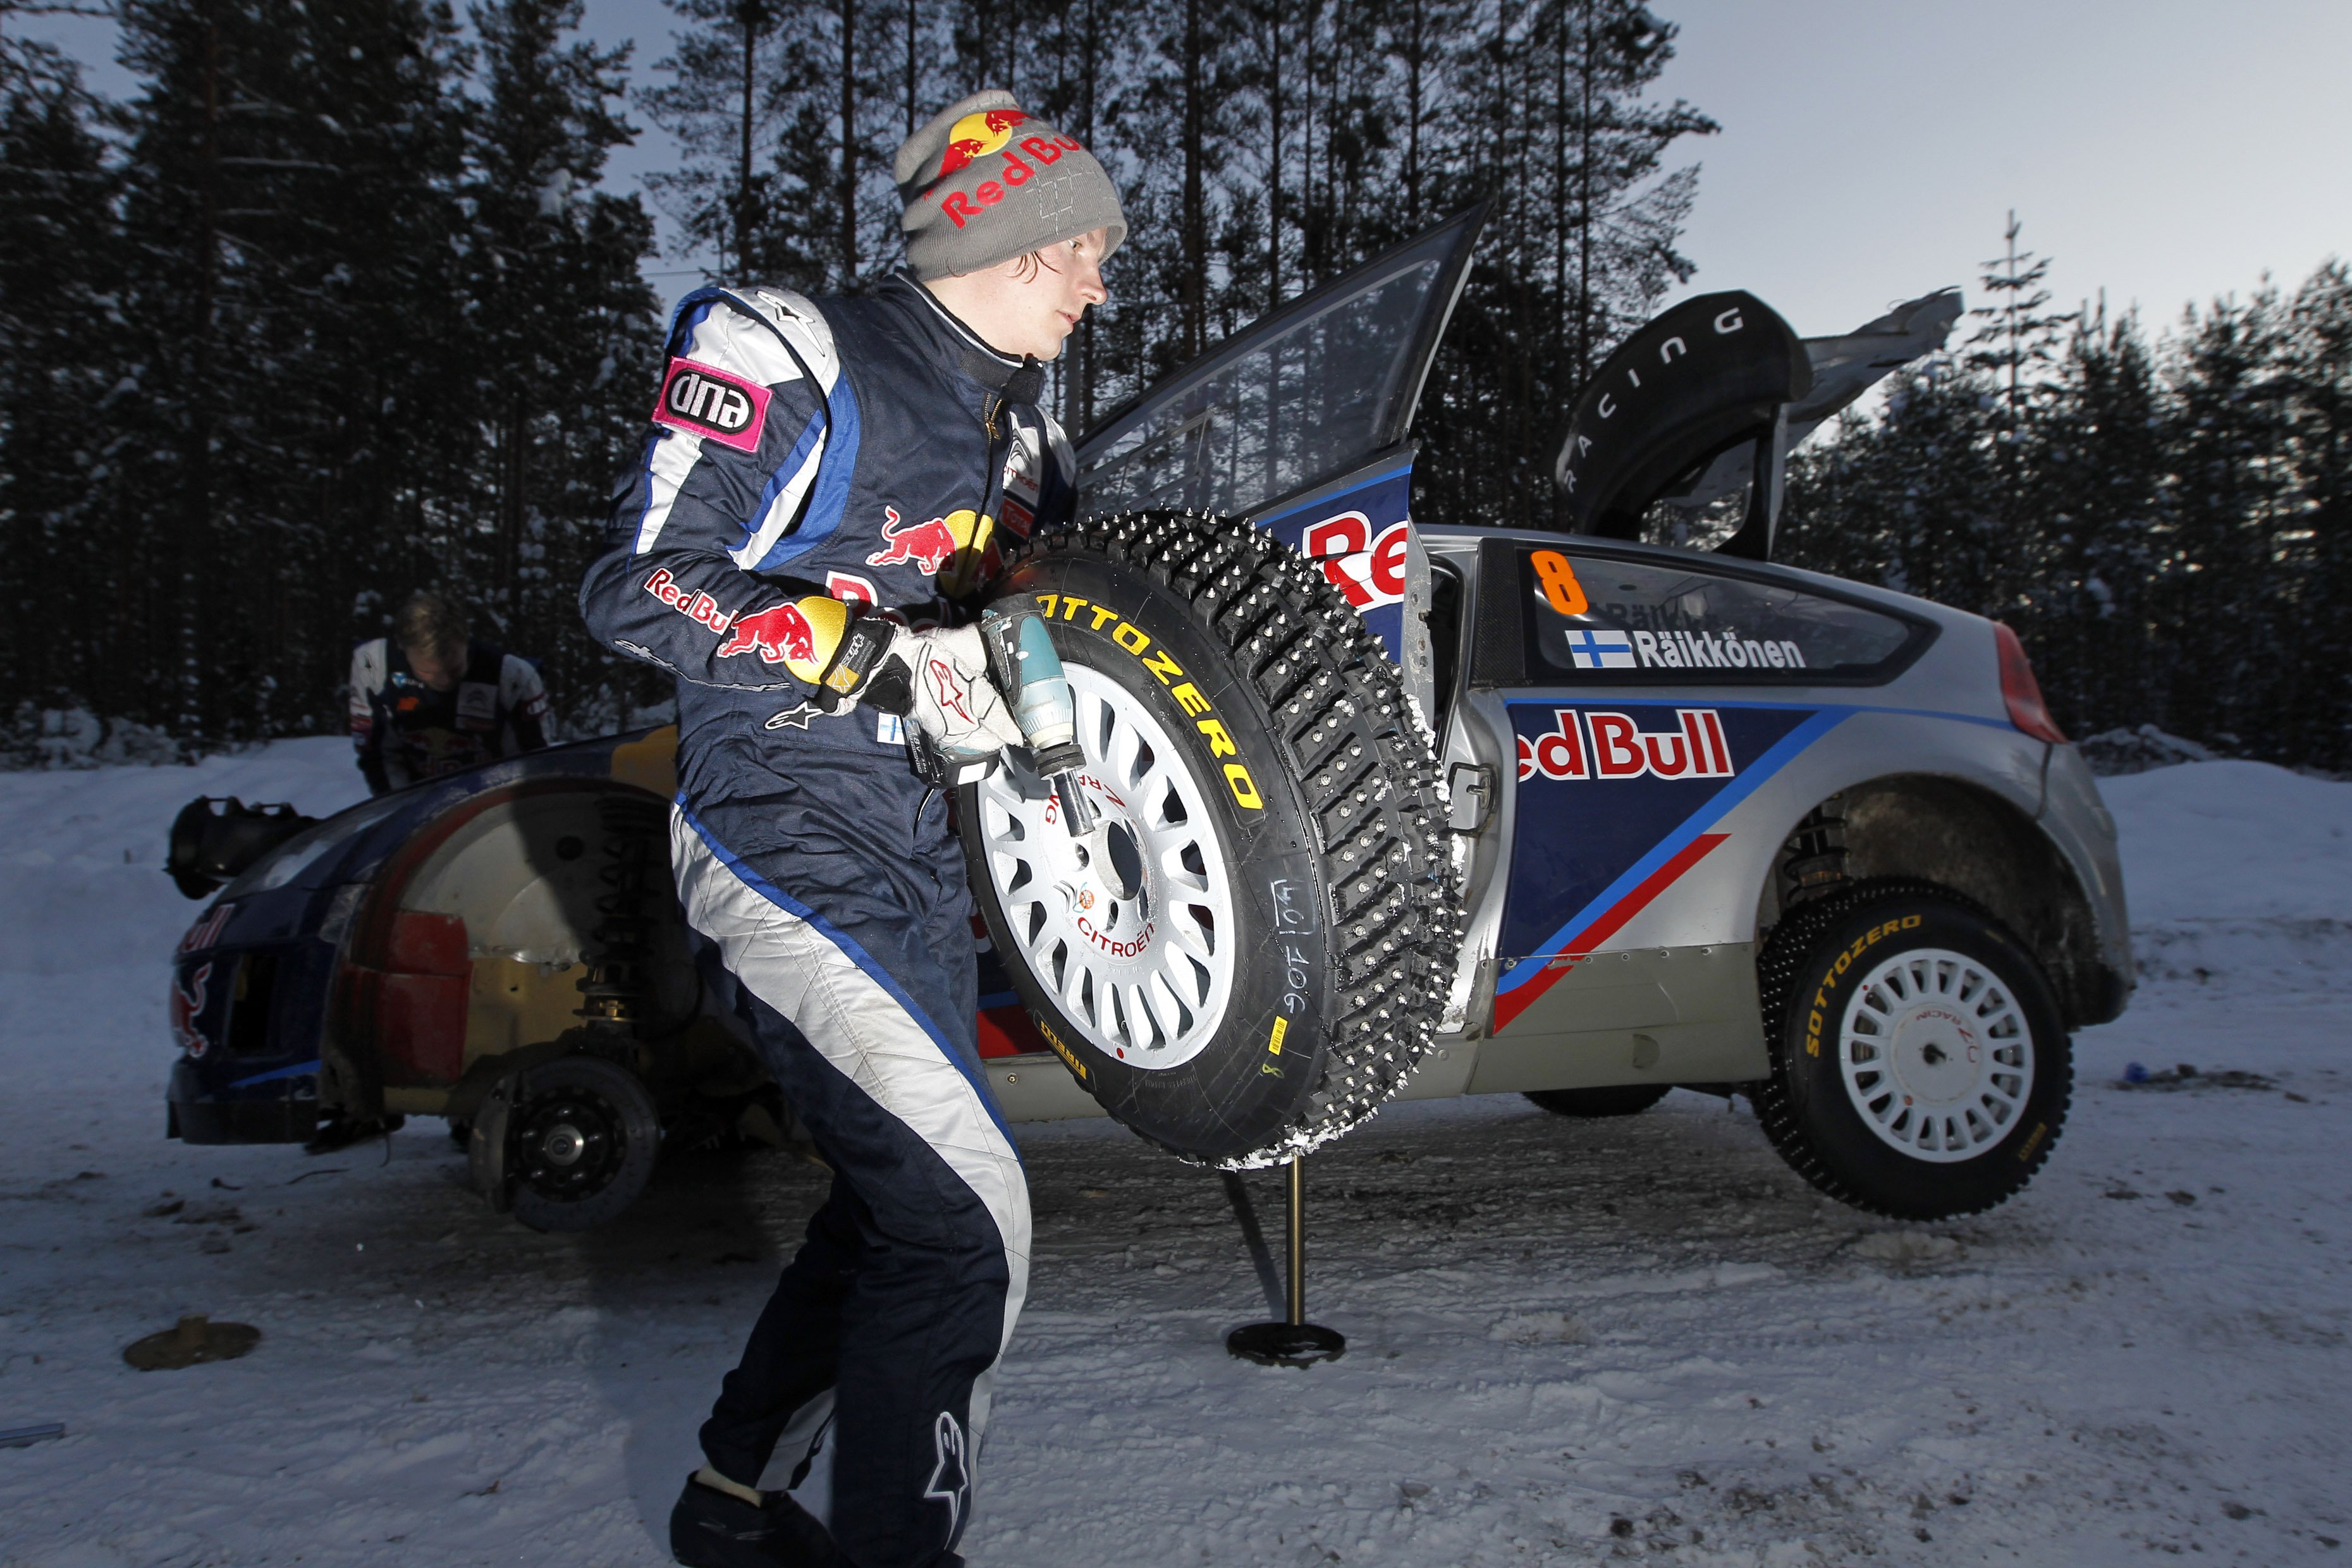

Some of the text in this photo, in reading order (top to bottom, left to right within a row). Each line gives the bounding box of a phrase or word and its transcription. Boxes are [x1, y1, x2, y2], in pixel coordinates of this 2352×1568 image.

[941, 135, 1082, 229] Red Bu
[1563, 307, 1744, 493] RACING
[644, 568, 702, 616] Red
[1530, 550, 1588, 615] 8
[1632, 630, 1806, 668] Räikkönen
[1584, 709, 1735, 780] Bull
[1077, 917, 1155, 957] CITROËN
[1806, 914, 1921, 1058] SOTTOZERO
